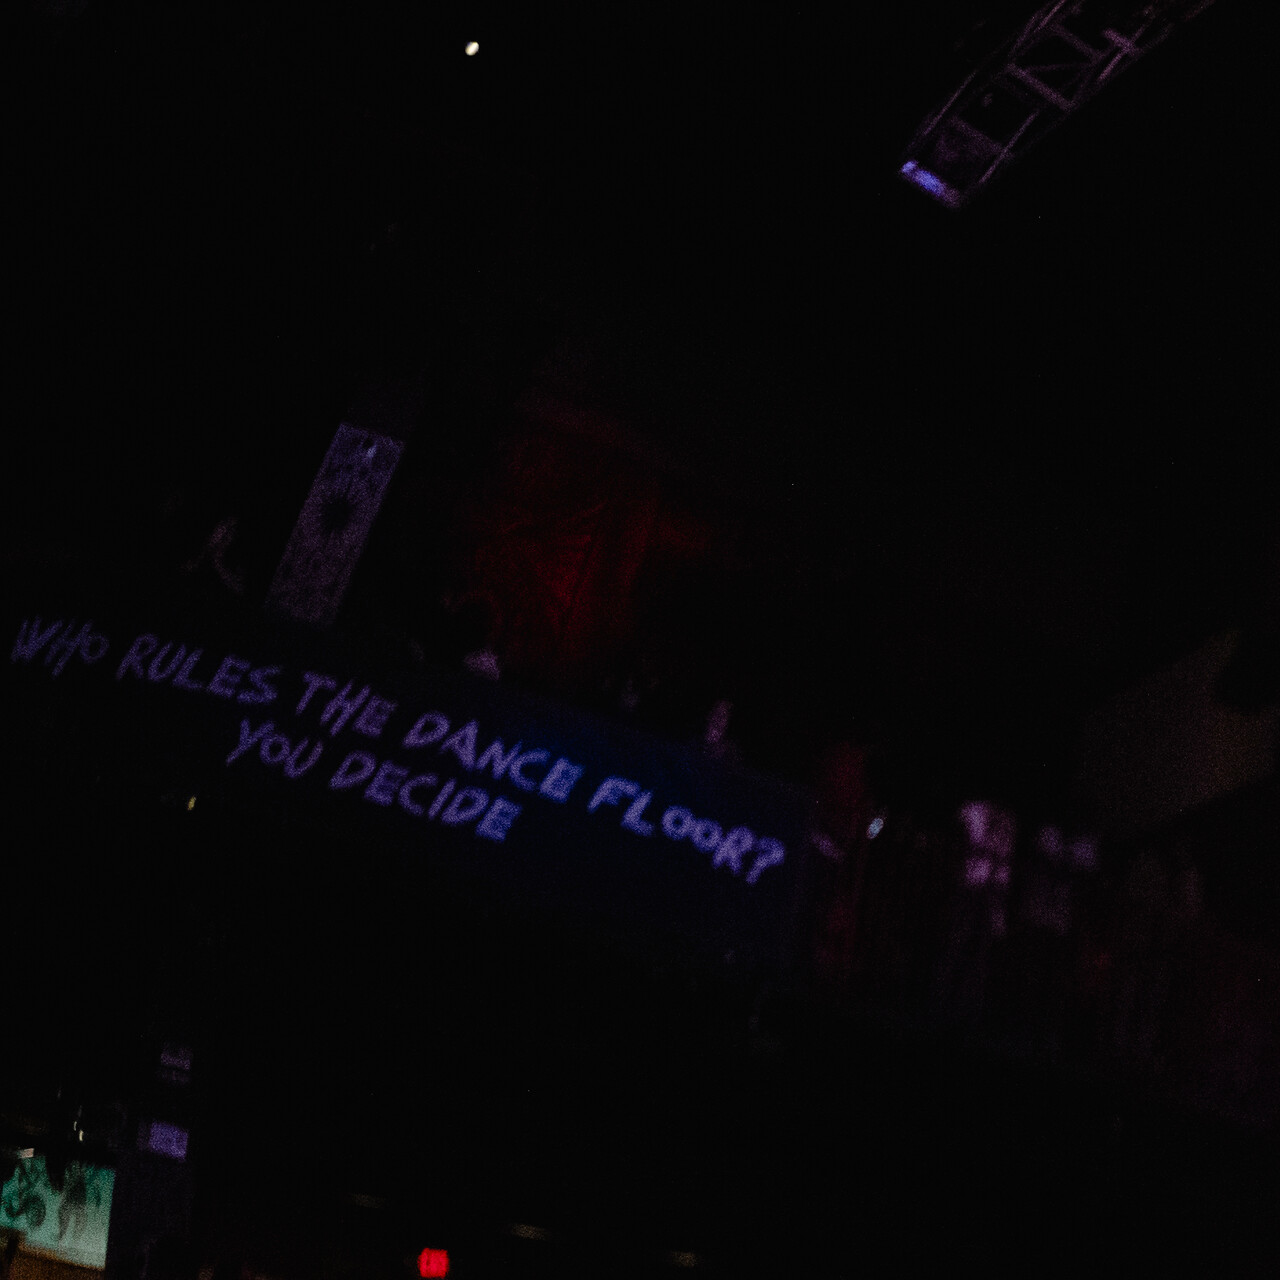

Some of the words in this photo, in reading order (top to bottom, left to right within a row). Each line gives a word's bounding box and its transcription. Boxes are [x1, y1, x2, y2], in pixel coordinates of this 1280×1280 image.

[116, 632, 283, 705] RULES
[295, 669, 399, 738] THE
[402, 709, 585, 804] DANCE
[587, 775, 786, 887] FLOOR?
[225, 717, 324, 780] YOU
[328, 750, 524, 843] DECIDE
